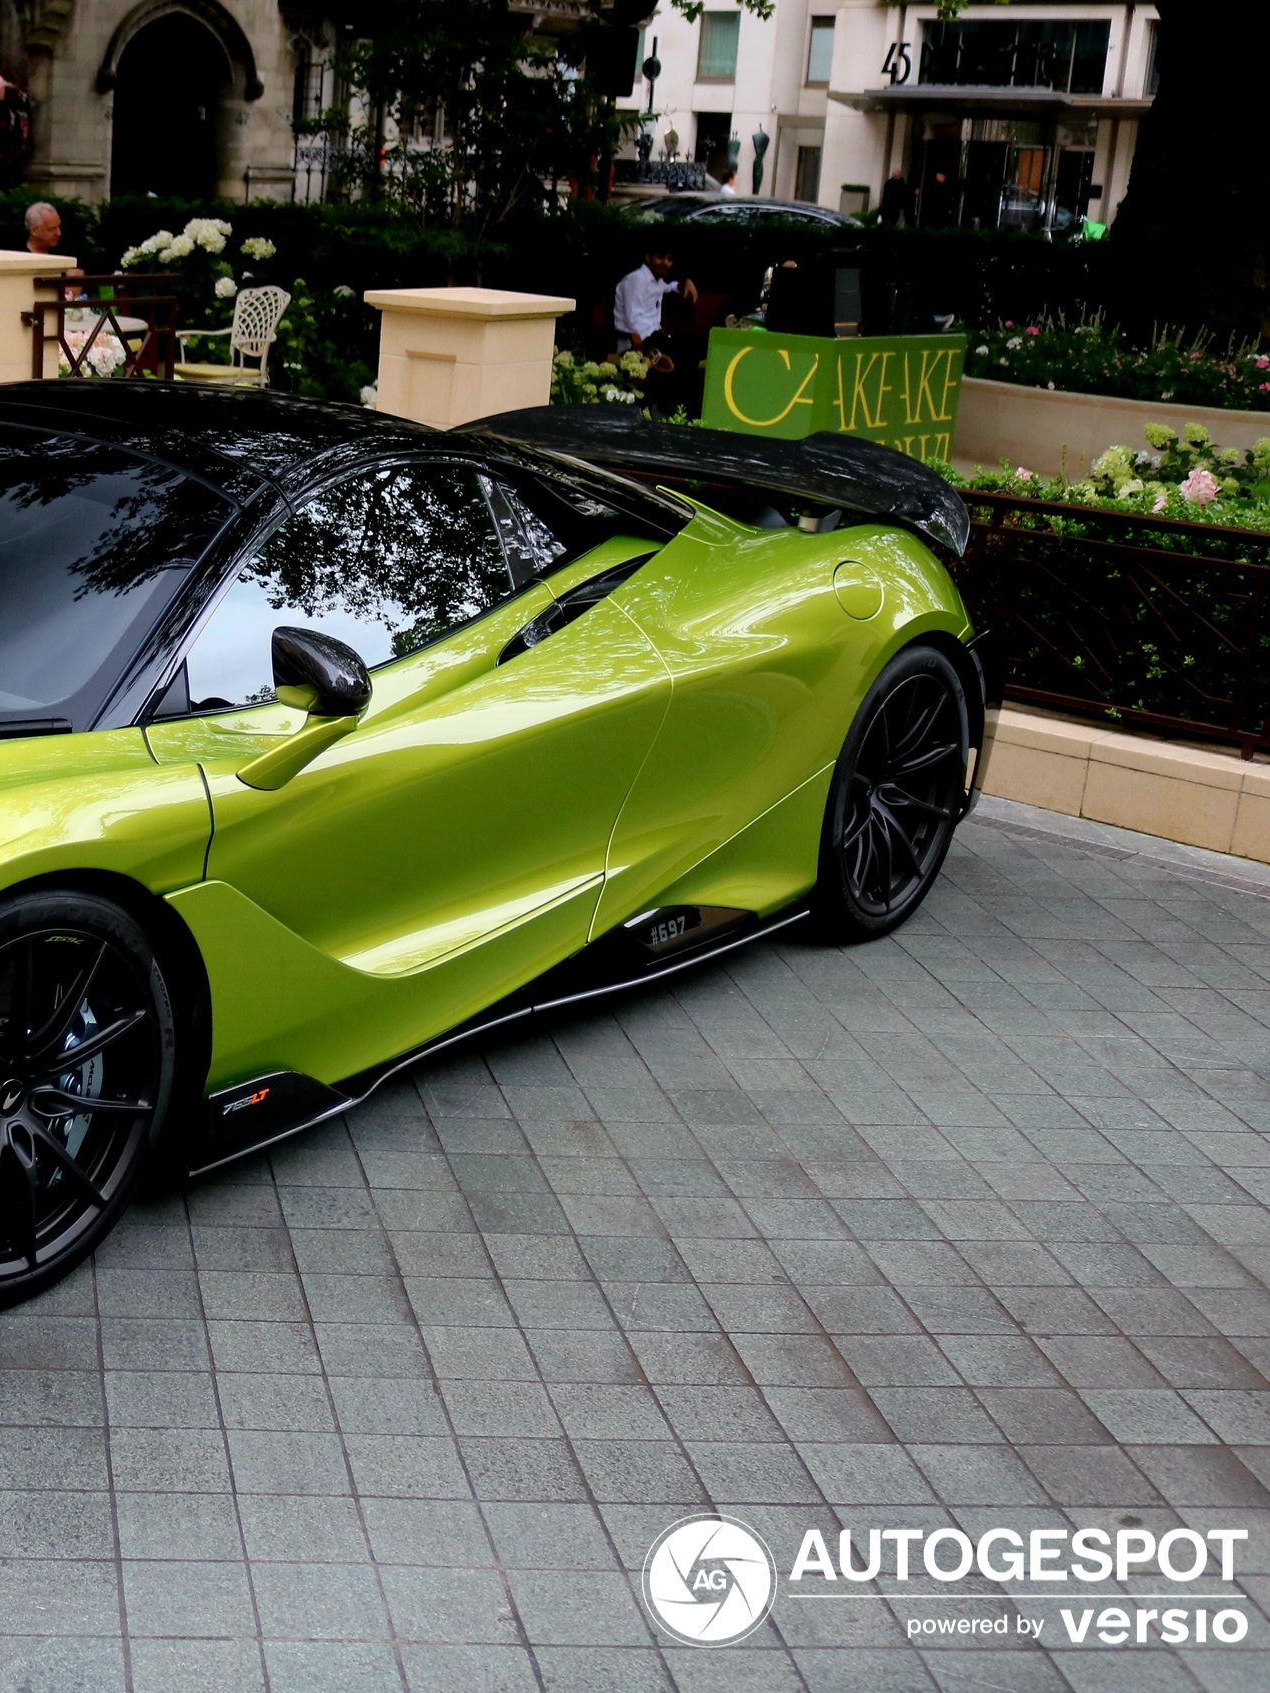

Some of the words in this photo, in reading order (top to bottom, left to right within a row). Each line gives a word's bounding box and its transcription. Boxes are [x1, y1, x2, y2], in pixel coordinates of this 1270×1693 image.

[881, 42, 911, 86] 45
[651, 916, 686, 946] #697
[222, 1088, 270, 1115] 765LT
